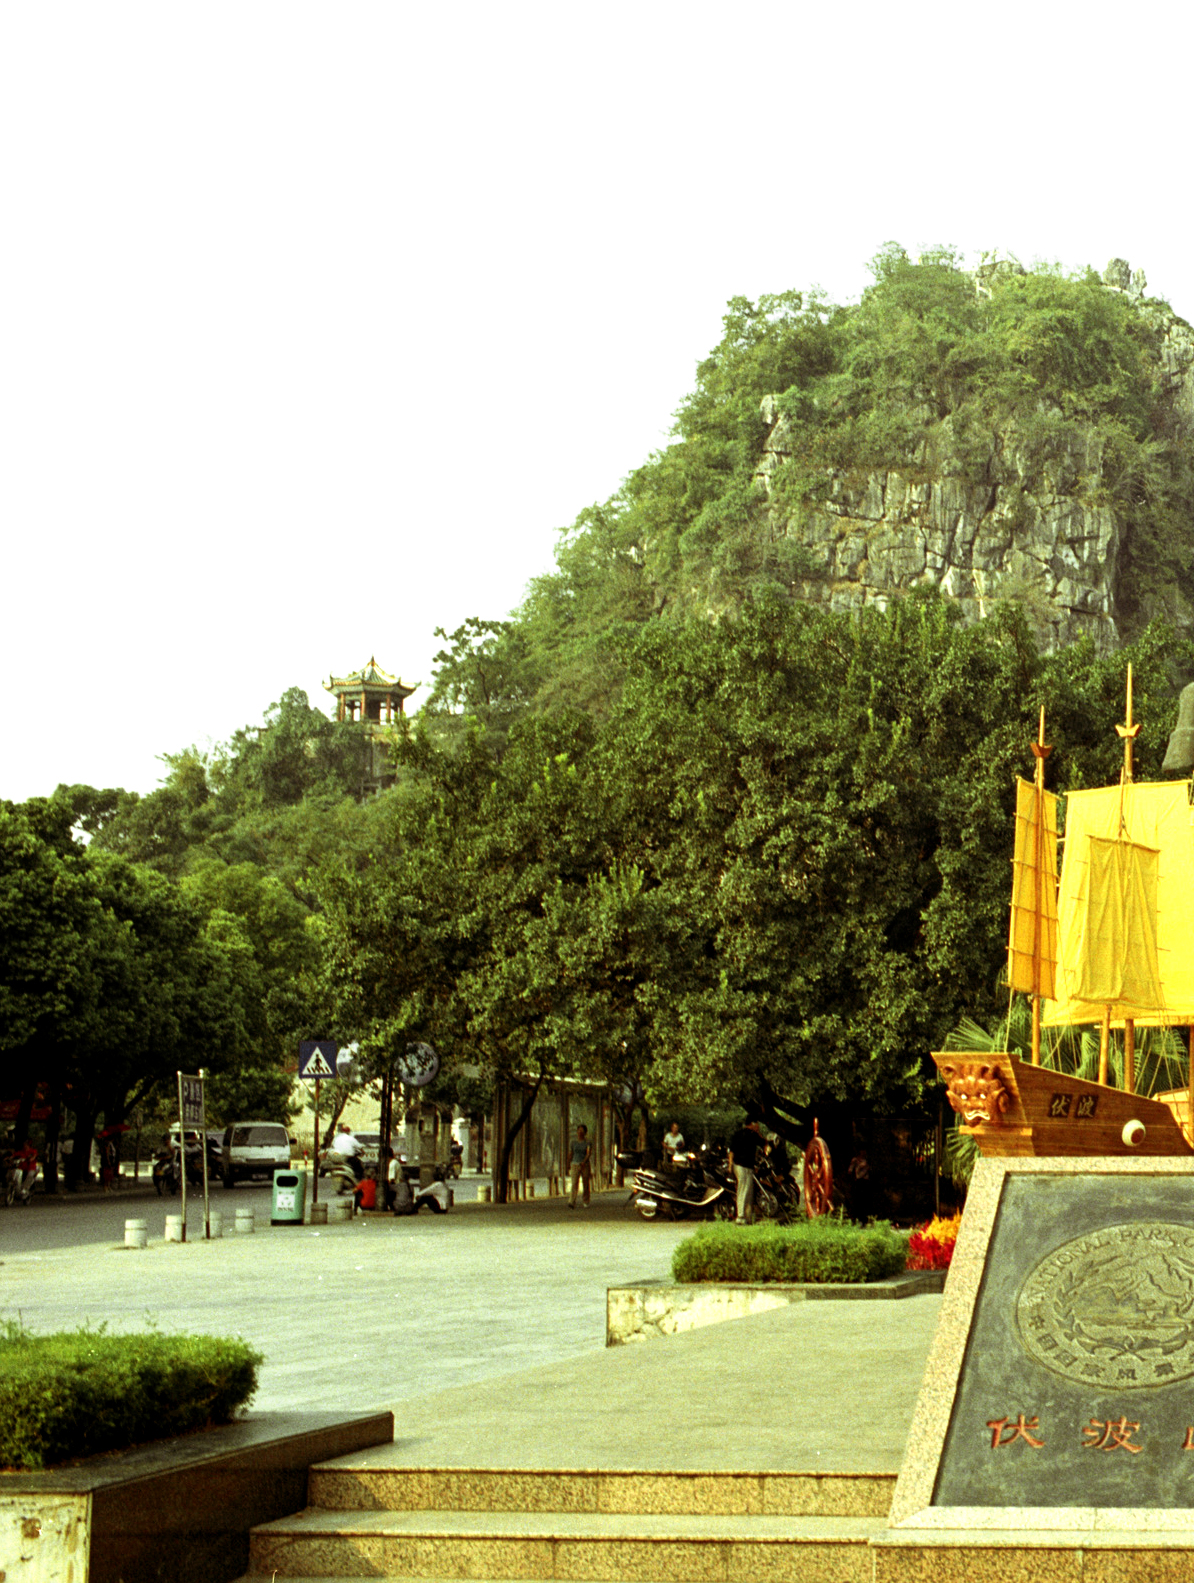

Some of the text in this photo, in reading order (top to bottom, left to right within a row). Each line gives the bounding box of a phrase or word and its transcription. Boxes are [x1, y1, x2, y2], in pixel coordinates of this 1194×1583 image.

[1052, 1095, 1095, 1117] 伏波
[1028, 1235, 1111, 1300] NATIONAL
[1119, 1227, 1178, 1248] PARK
